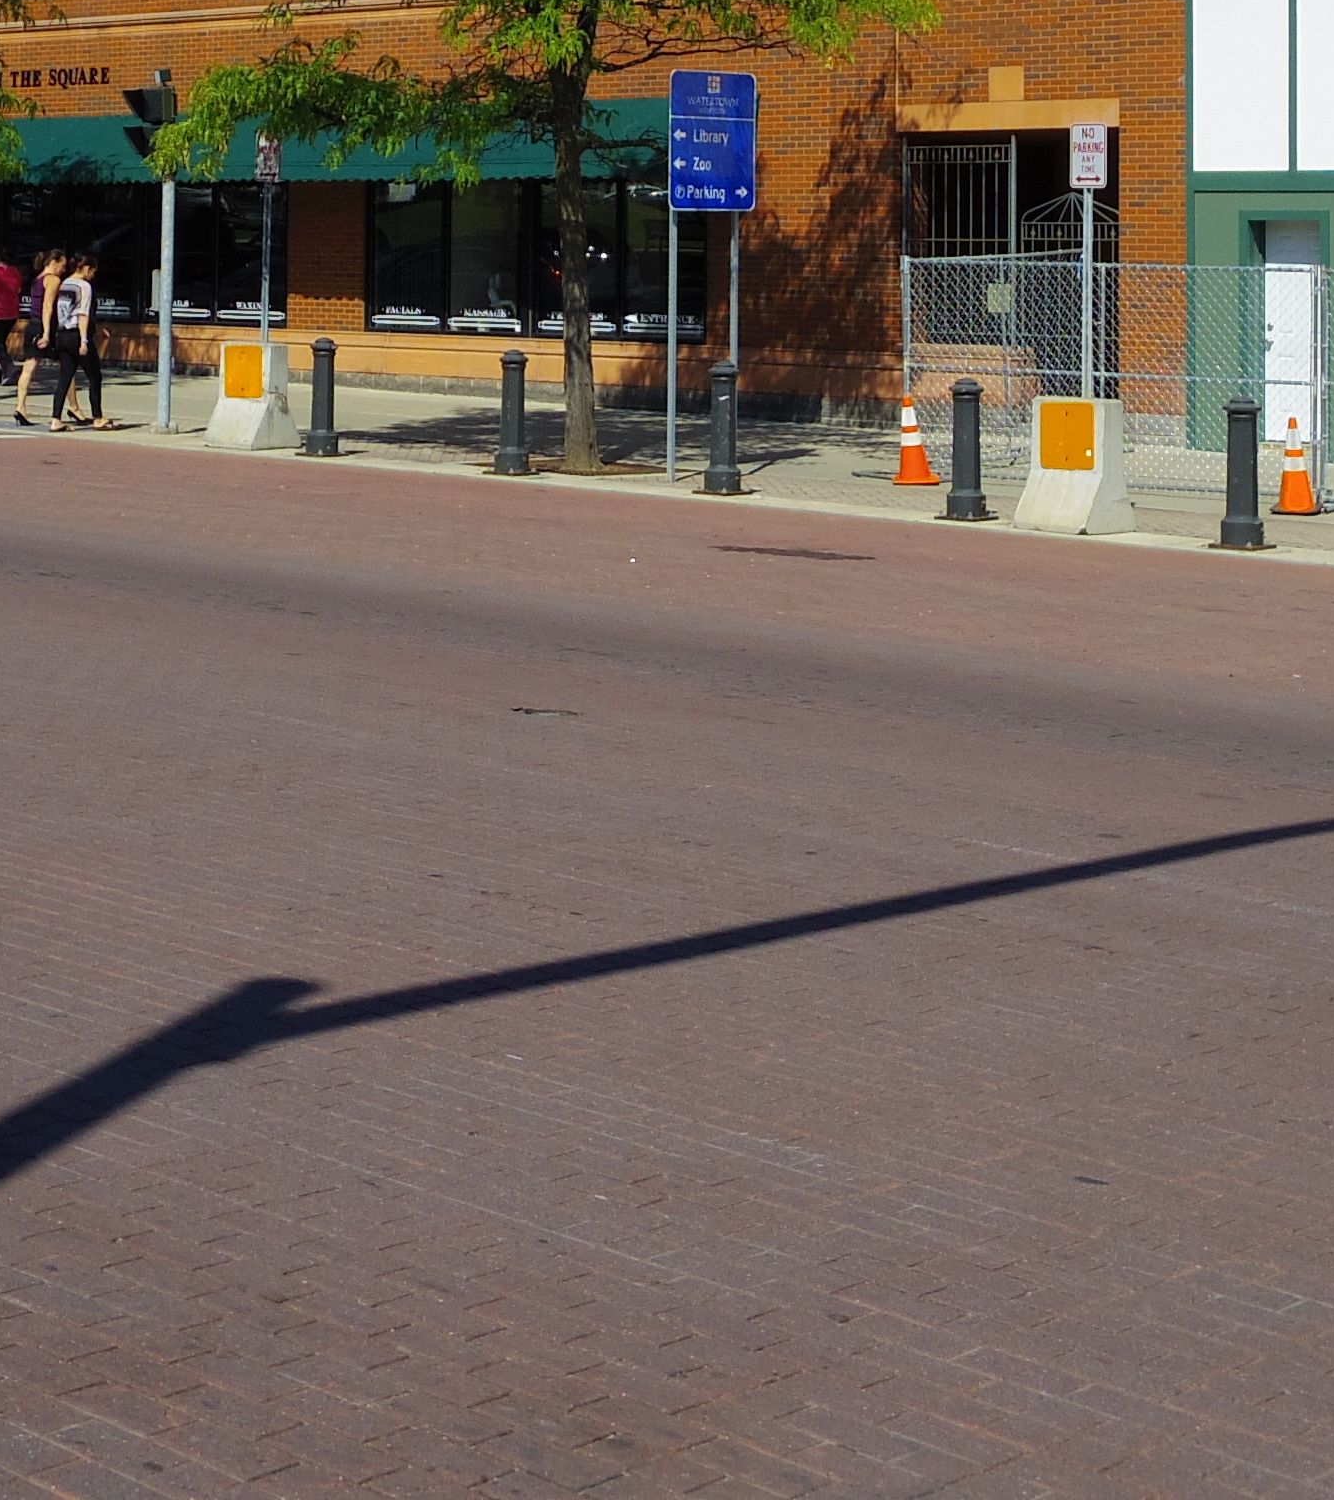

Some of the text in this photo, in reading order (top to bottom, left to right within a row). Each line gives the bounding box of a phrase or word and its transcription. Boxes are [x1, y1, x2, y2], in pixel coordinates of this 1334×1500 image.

[10, 70, 42, 88] THE
[48, 67, 110, 90] SQUARE
[693, 128, 729, 147] Library
[1082, 128, 1095, 139] NO
[1072, 141, 1104, 153] PARKING
[692, 156, 711, 171] Zoo
[687, 184, 725, 203] Parking
[235, 301, 263, 310] WAXIN
[385, 305, 422, 315] FACIALS
[463, 307, 507, 318] MASSAGE
[639, 313, 696, 325] ENTRNCE
